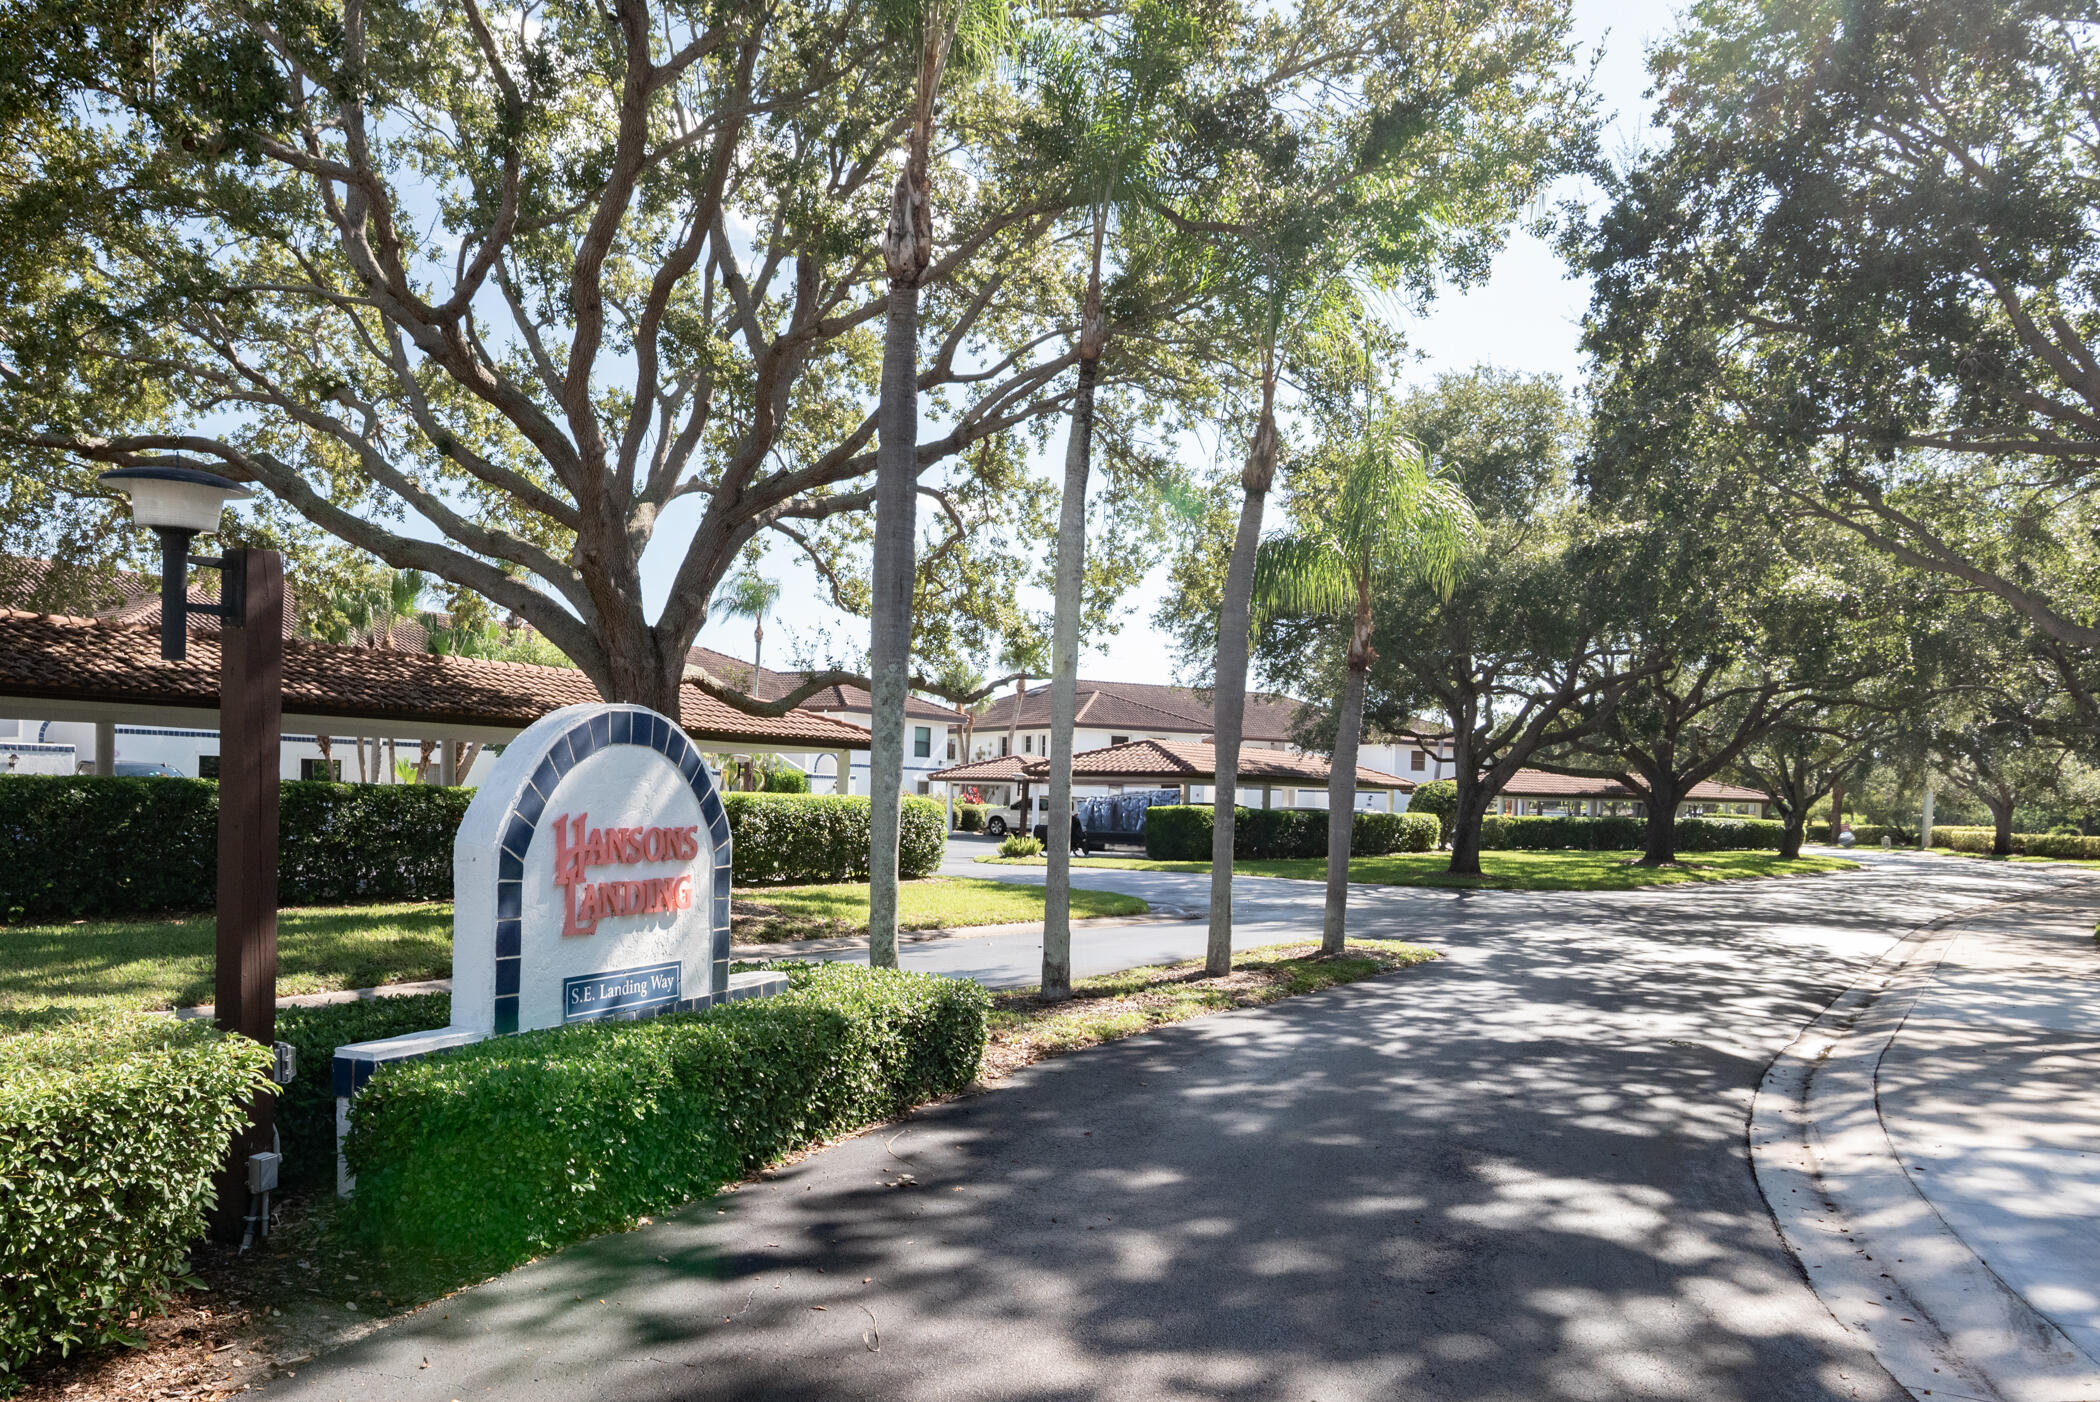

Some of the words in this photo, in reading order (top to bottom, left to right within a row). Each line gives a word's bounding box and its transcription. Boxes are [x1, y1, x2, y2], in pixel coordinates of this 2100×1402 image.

[553, 812, 698, 885] HANSONS
[562, 865, 692, 936] LANDING
[571, 986, 596, 1004] S.E.
[600, 980, 648, 997] Landing
[650, 974, 675, 992] Way
